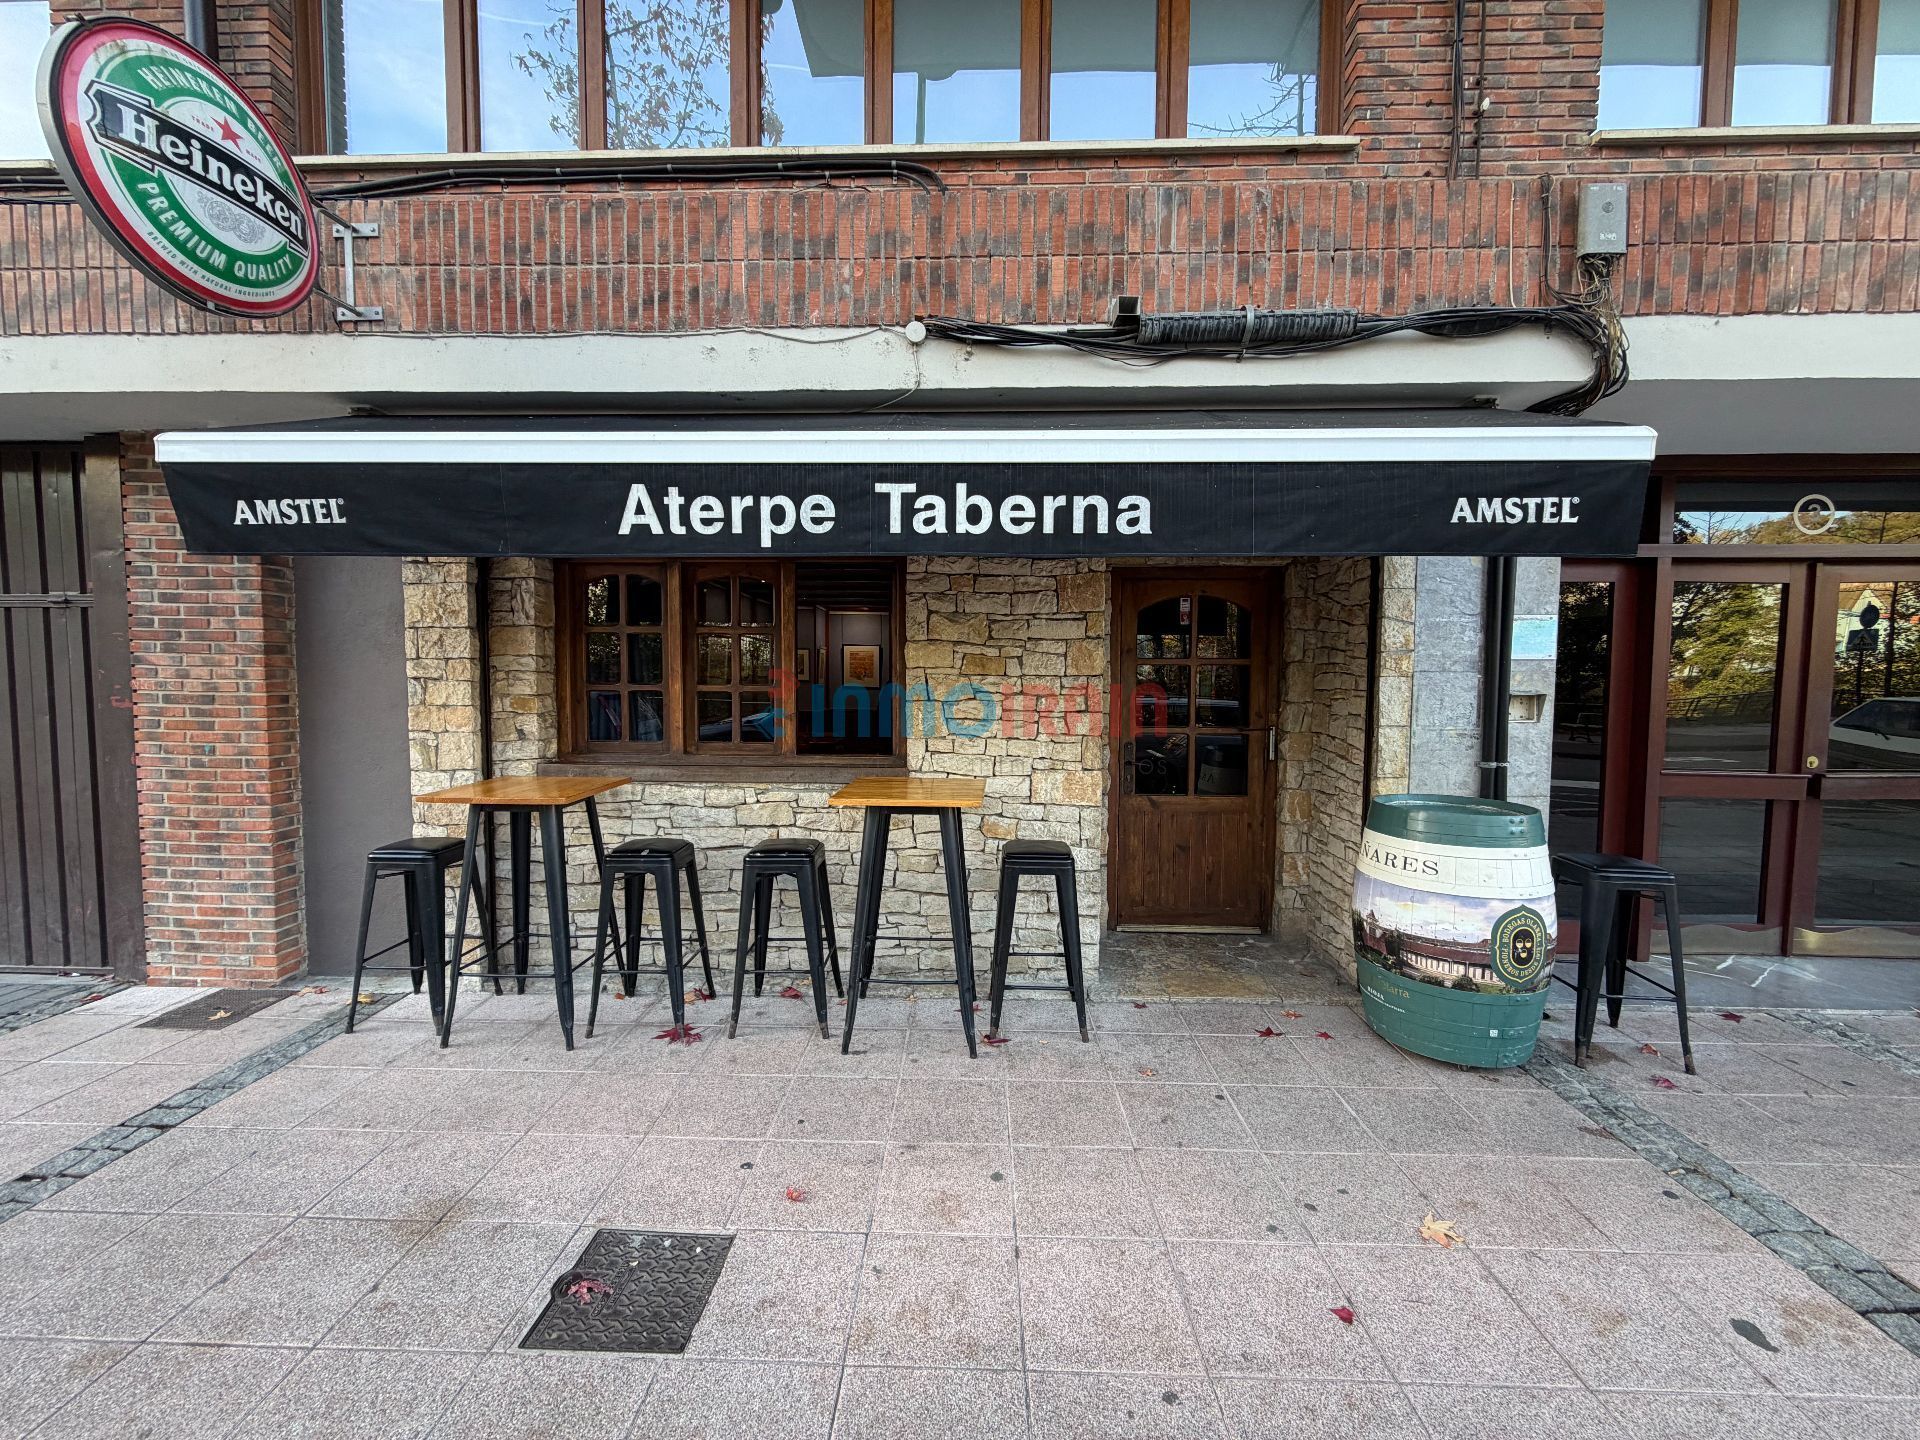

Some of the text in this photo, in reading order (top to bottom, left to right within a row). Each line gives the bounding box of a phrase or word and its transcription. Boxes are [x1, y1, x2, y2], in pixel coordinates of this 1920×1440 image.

[138, 65, 240, 118] HEINEKEN
[248, 117, 283, 169] BEER
[117, 103, 304, 241] Heineken
[137, 182, 293, 281] PREMIUM QUALITY
[146, 231, 177, 259] BREWED
[179, 260, 199, 277] WITH
[201, 273, 232, 293] NATURAL
[617, 482, 1153, 548] Aterpe Taberna
